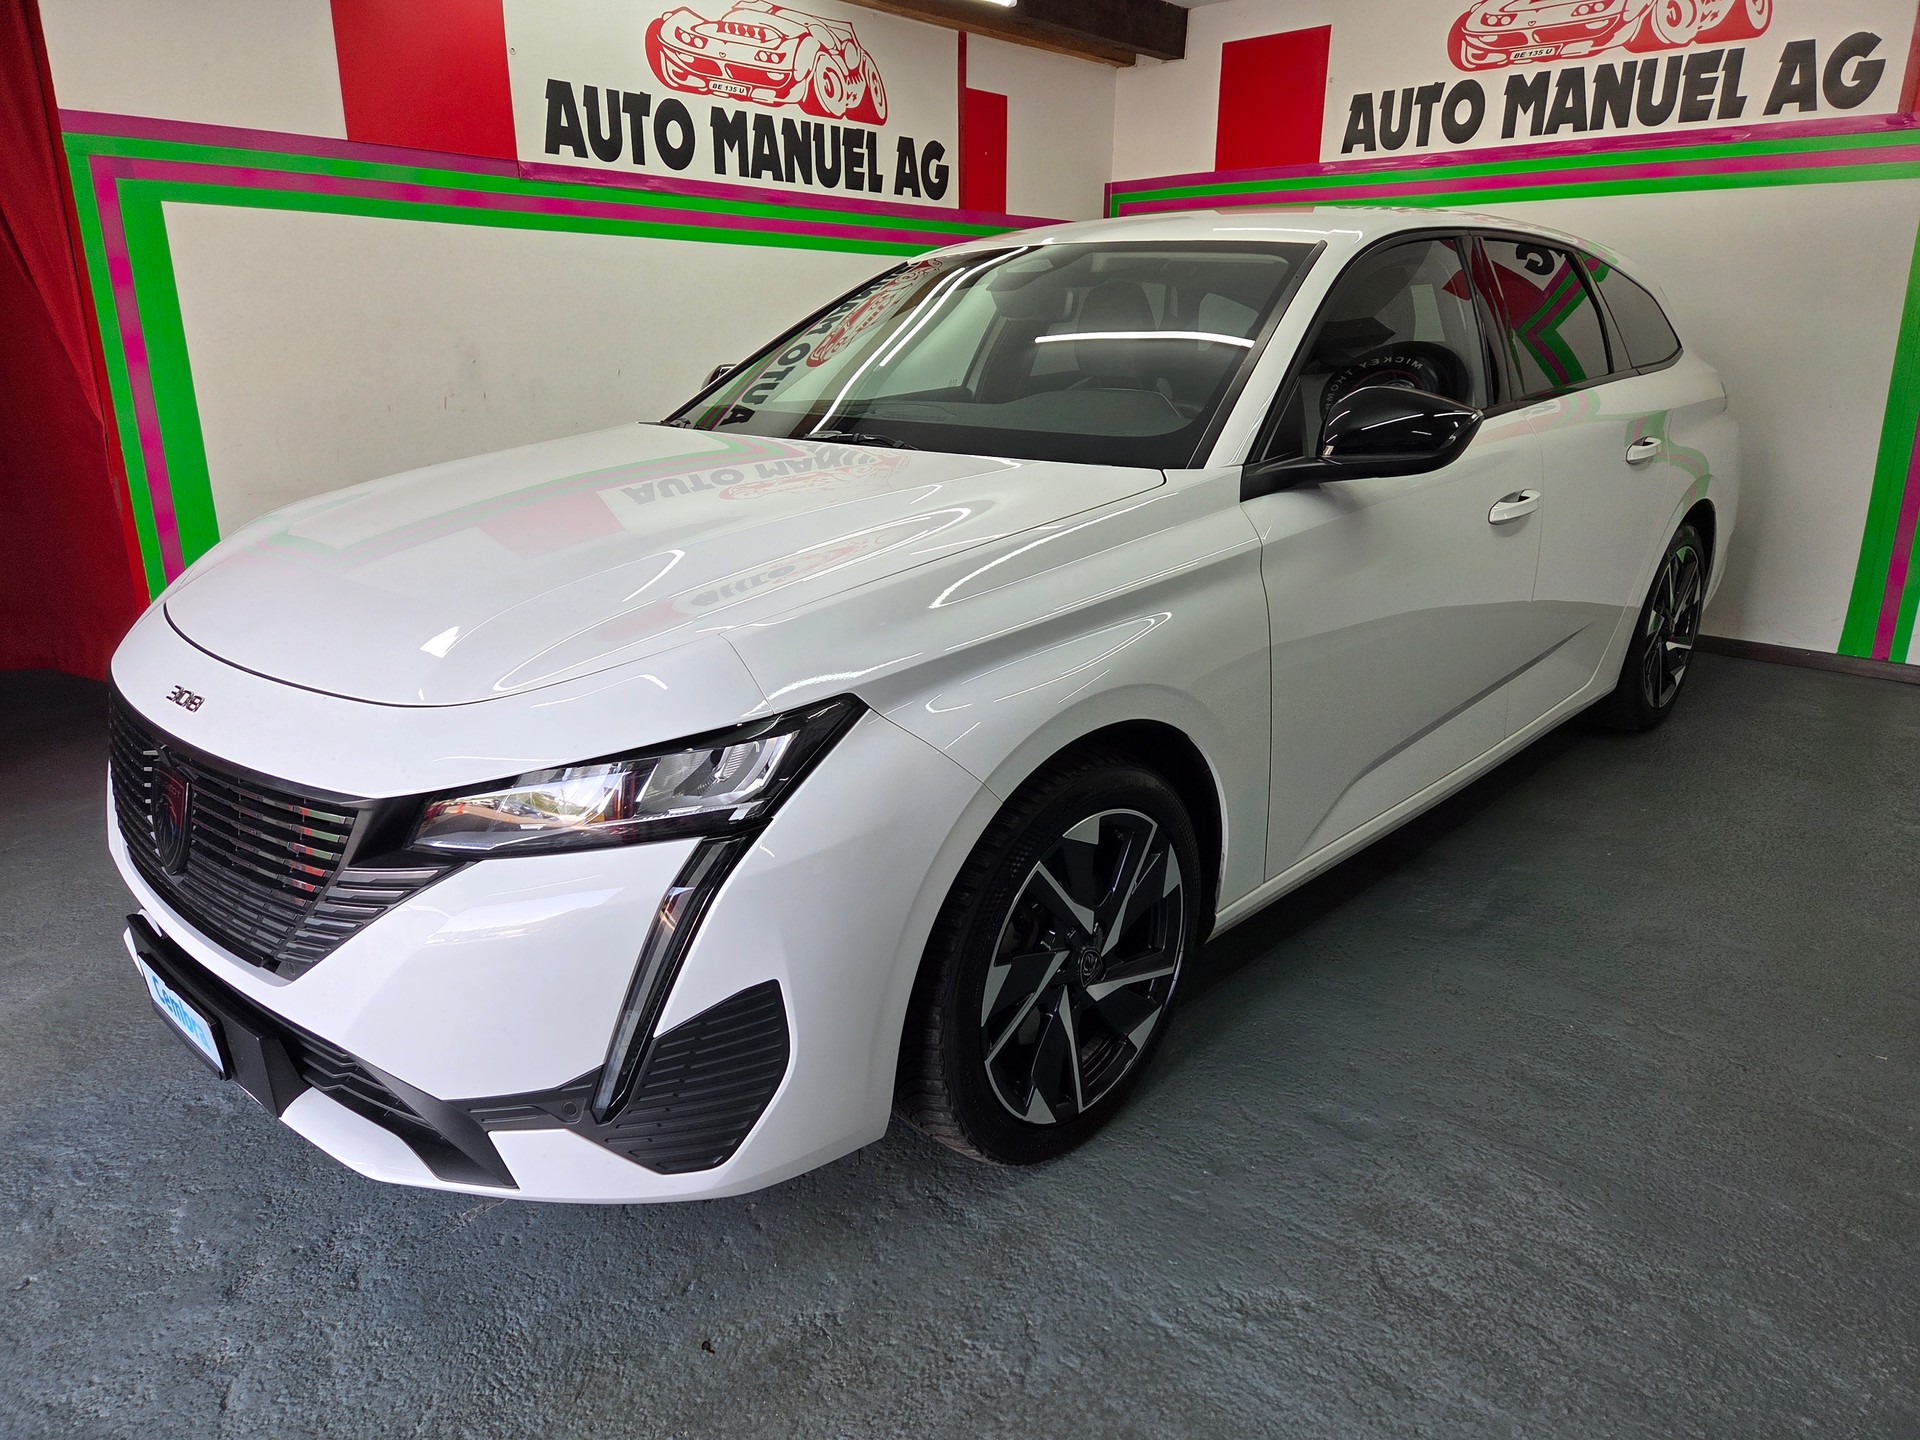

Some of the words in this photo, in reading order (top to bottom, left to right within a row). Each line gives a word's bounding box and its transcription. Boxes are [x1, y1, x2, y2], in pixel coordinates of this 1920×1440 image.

[1513, 51, 1527, 59] BE
[1528, 49, 1543, 57] 135
[711, 83, 722, 91] BE
[725, 85, 737, 93] 135
[1340, 78, 1486, 155] AUTO
[1500, 47, 1748, 140] MANUEL
[1763, 31, 1887, 117] AG
[544, 79, 696, 171] AUTO
[709, 106, 884, 194] MANUEL
[893, 135, 950, 201] AG
[165, 684, 206, 713] 308
[151, 974, 212, 1052] Cembra
